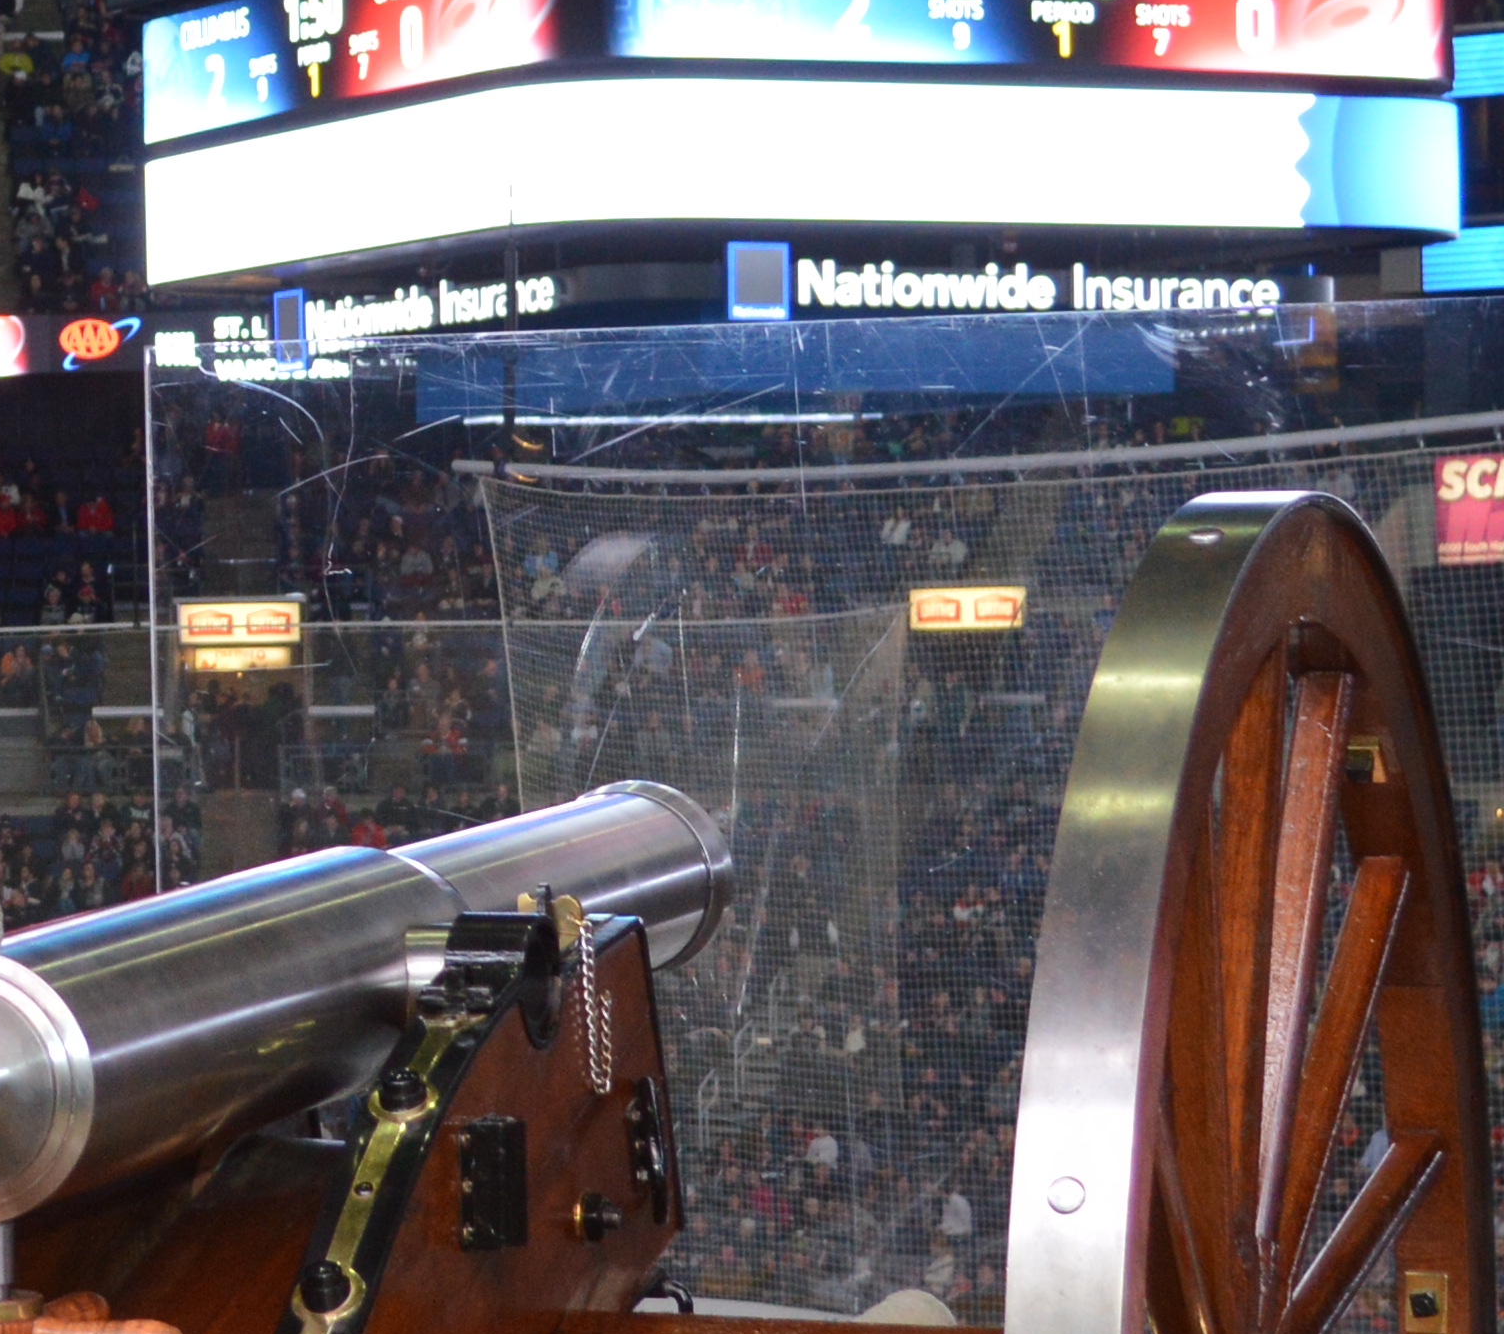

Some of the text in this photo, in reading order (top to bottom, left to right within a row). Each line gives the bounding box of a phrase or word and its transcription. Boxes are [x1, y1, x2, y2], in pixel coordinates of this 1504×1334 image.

[180, 6, 251, 52] COLUMBUS
[1031, 0, 1095, 25] PERIOD
[1135, 3, 1191, 27] SHOTS
[399, 5, 424, 69] 0
[952, 21, 971, 50] 9
[1052, 21, 1072, 58] 1
[1152, 28, 1171, 56] 7
[204, 53, 227, 110] 2
[307, 62, 321, 99] 1
[796, 258, 1280, 311] Nationwide Insurance
[305, 285, 434, 341] Nationwide
[68, 323, 114, 354] AAA
